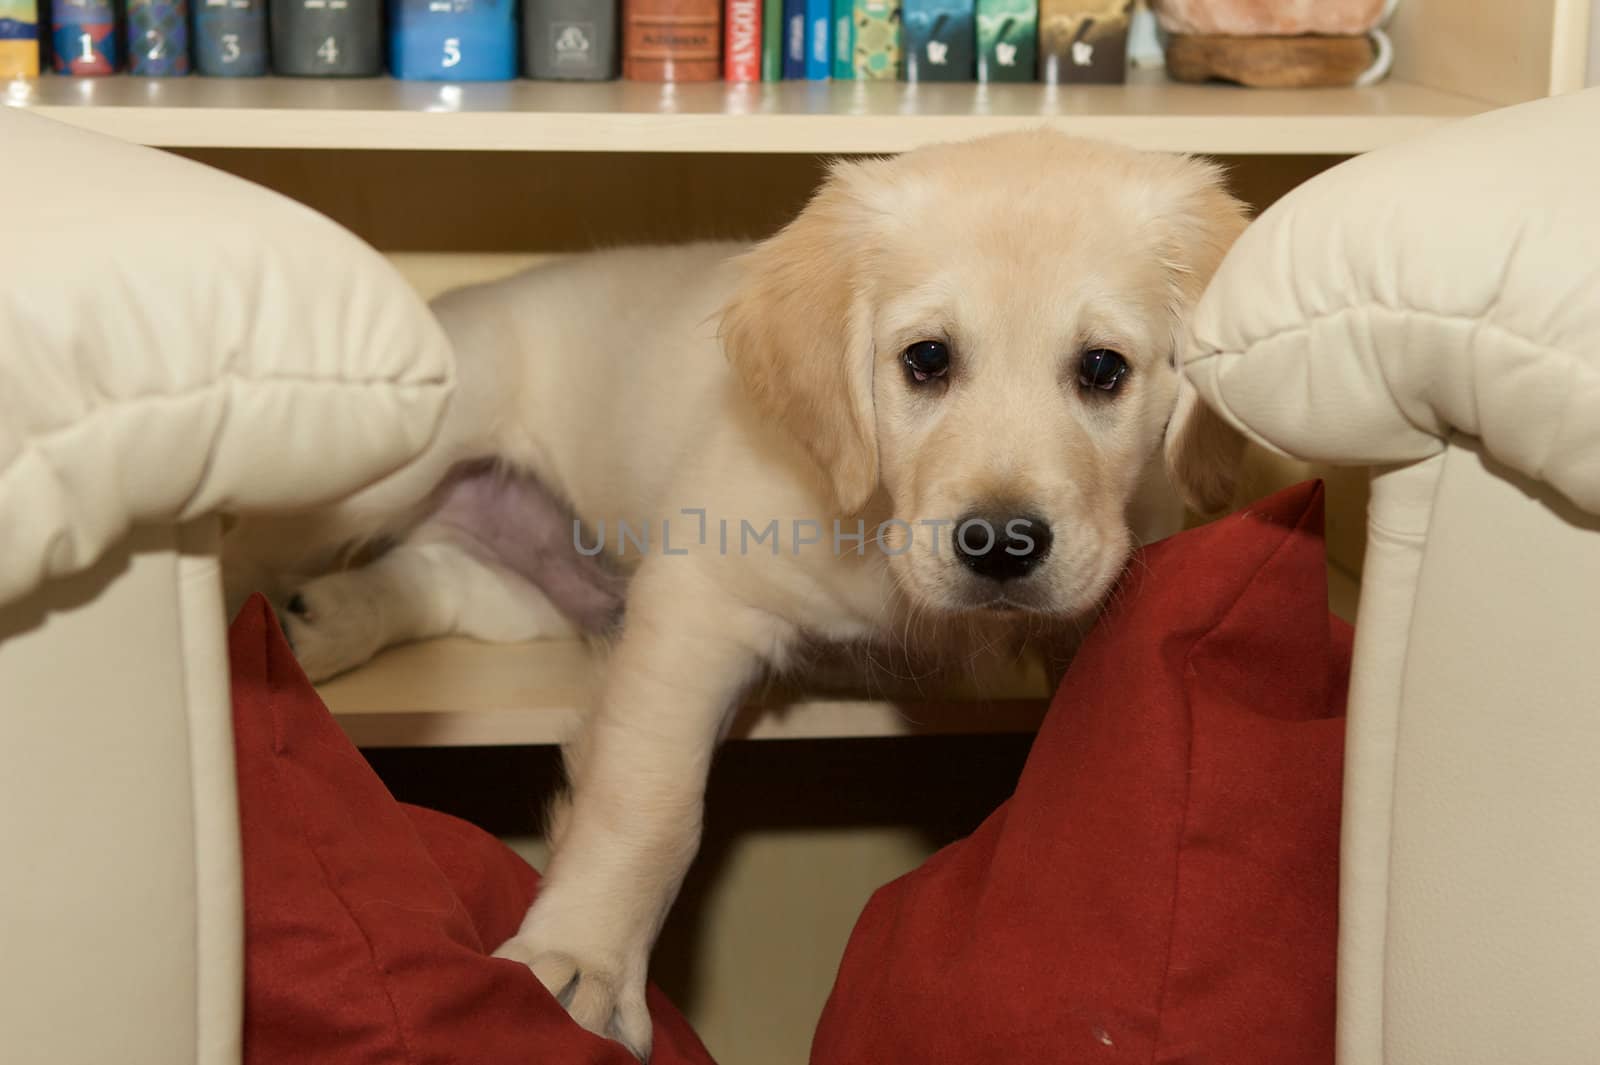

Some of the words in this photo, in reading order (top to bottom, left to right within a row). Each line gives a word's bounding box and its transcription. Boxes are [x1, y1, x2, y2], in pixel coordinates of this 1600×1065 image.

[79, 33, 97, 63] 1
[146, 29, 165, 60] 2
[221, 34, 241, 63] 3
[317, 36, 339, 64] 4
[442, 38, 461, 68] 5
